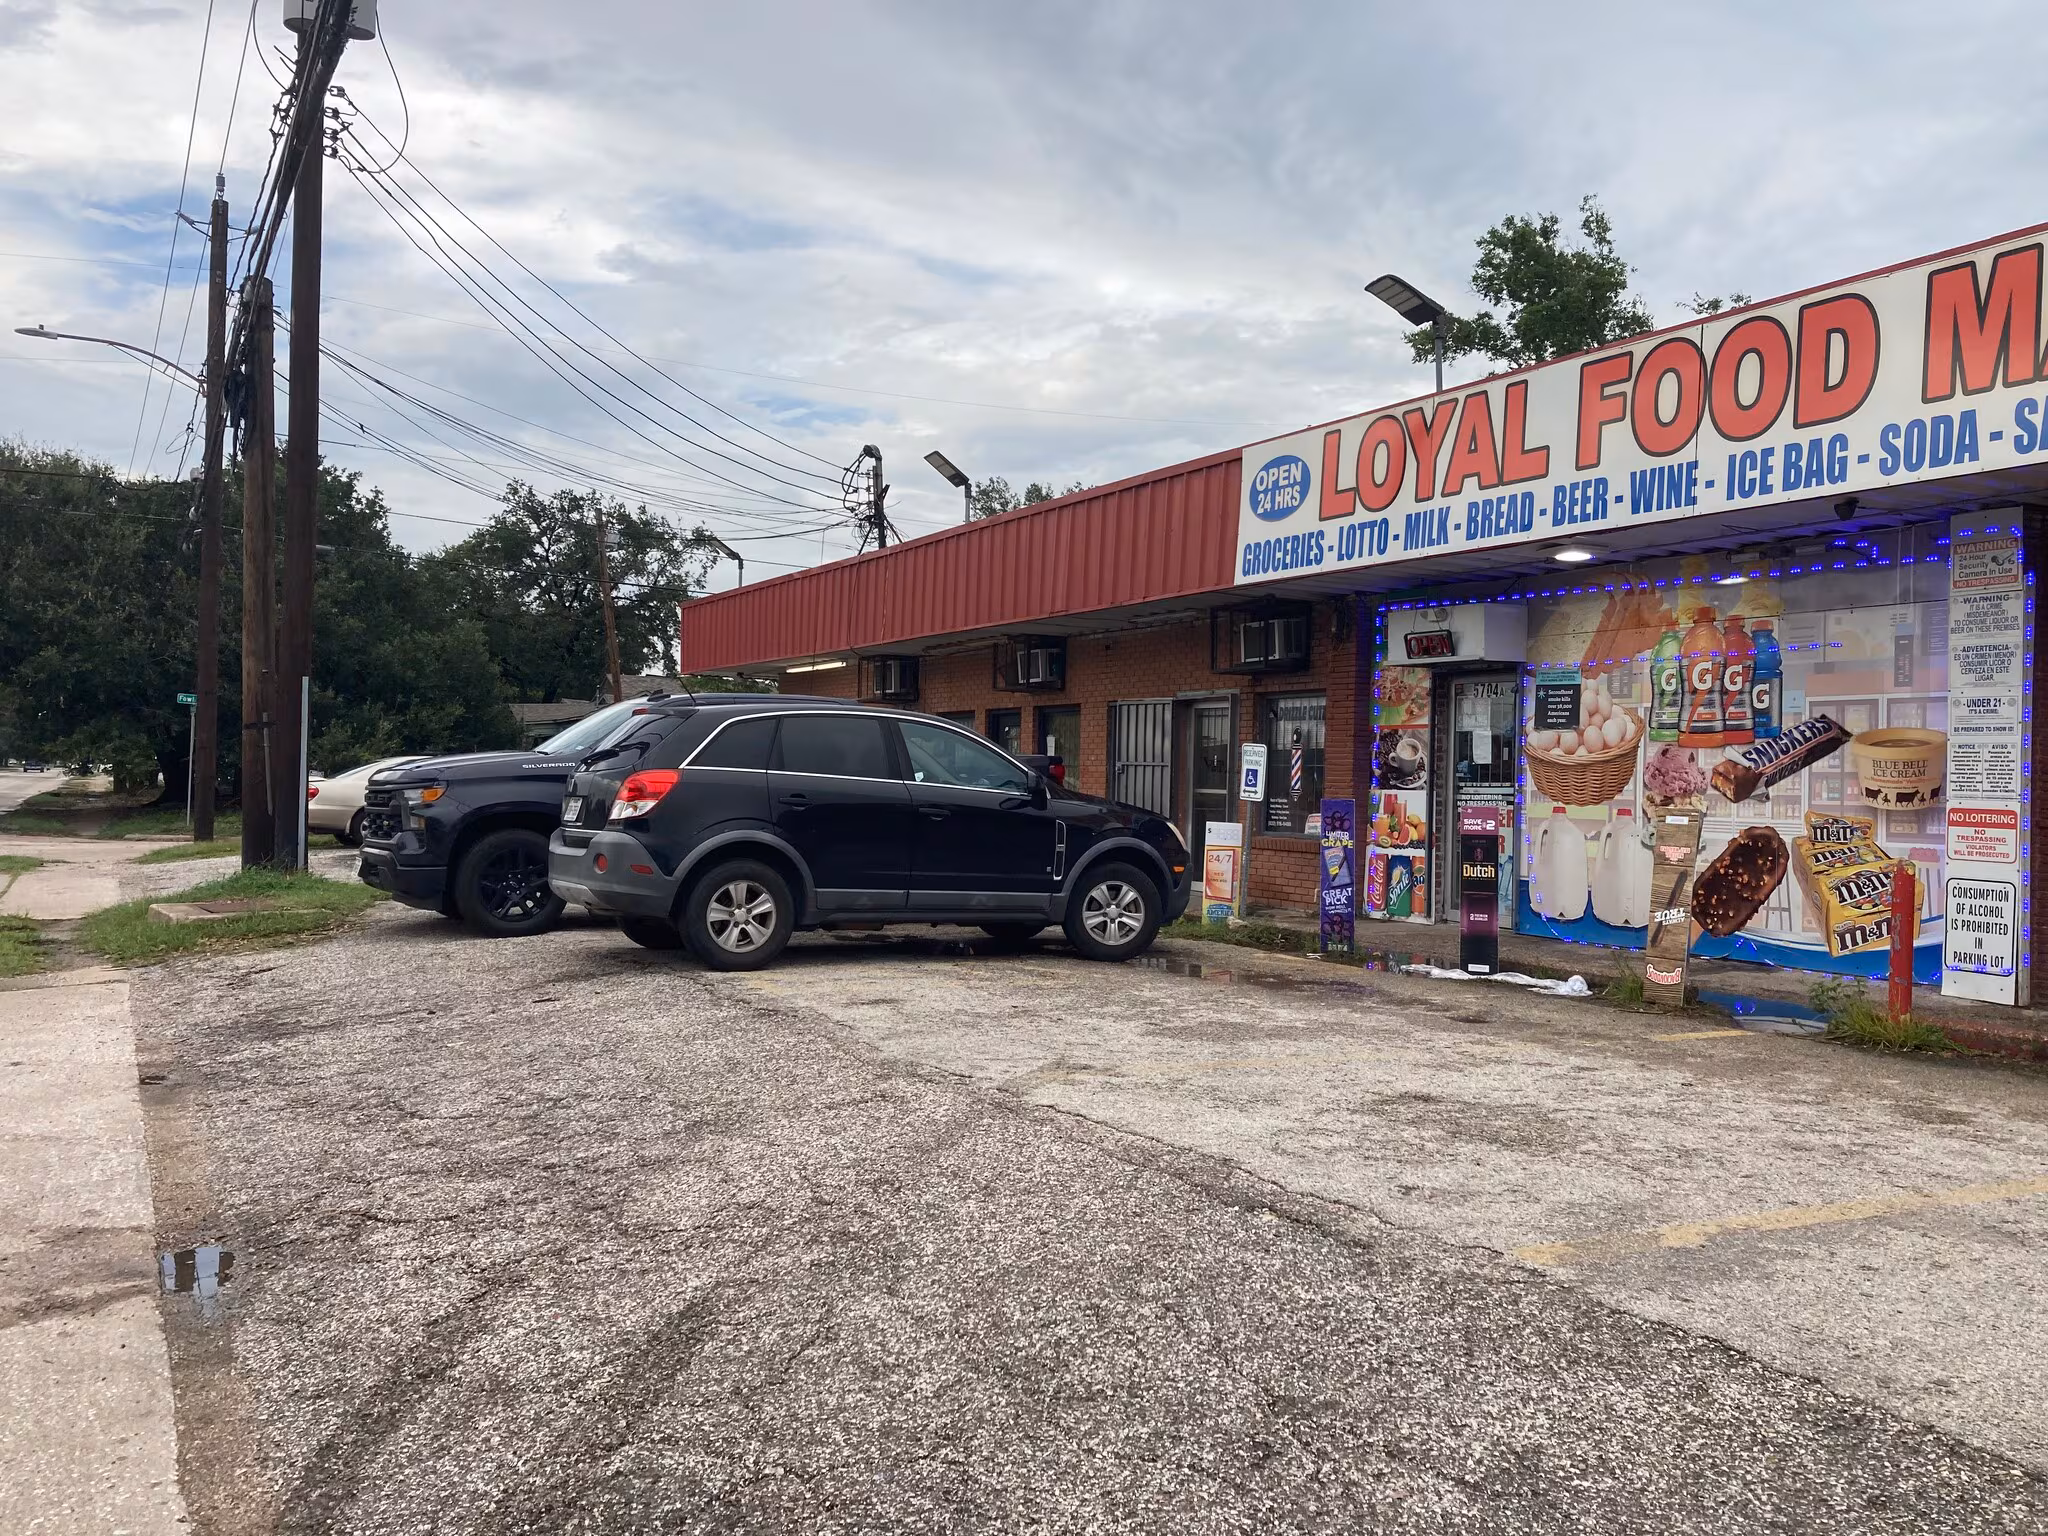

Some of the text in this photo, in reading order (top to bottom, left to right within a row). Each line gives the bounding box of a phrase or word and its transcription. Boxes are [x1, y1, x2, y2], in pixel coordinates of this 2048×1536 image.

[1319, 242, 2048, 521] LOYAL FOOD M
[1255, 461, 1303, 491] OPEN
[1242, 529, 1325, 577] GROCERIES
[1337, 517, 1389, 562] LOTTO
[1403, 505, 1451, 551] MILK
[1465, 491, 1535, 541] BREAD
[1552, 477, 1609, 527] BEER
[1630, 459, 1699, 515] WINE
[1726, 446, 1775, 501] ICE
[1782, 433, 1848, 492] BAG
[1879, 409, 1980, 477] SODA
[1257, 487, 1301, 514] 24 HRS
[1956, 538, 2017, 554] WARNING
[1959, 553, 1987, 562] 24 Hour
[1959, 561, 1989, 570] Security
[1959, 570, 1988, 579] Camera
[1968, 576, 2015, 586] TRESPASSING
[1962, 618, 1988, 626] CONSUME
[1989, 616, 2009, 624] LIQUOR
[1950, 626, 1965, 634] BEER
[1993, 623, 2020, 631] PREMISES
[1408, 634, 1451, 656] OPEN
[1971, 652, 1992, 660] CRIMEN
[1960, 660, 1988, 668] CONSUMIR
[1989, 659, 2006, 667] LICOR
[1960, 667, 1986, 675] CERVEZA
[1966, 698, 2001, 708] UNDER 21
[1741, 719, 1833, 771] SNICKERS
[1872, 759, 1929, 770] BLUE BELL
[1873, 768, 1926, 778] ICE CREAM
[1950, 812, 2015, 824] NO LOITERING
[1486, 820, 1495, 830] 2
[1321, 838, 1354, 849] GRAPE
[1956, 835, 2007, 843] TRESPASSING
[1208, 854, 1232, 863] 24/7
[1975, 851, 2010, 859] PROSECUTED
[1463, 864, 1495, 878] Dutch
[1322, 887, 1353, 899] GREAT
[1389, 873, 1409, 905] Sprite
[1952, 885, 2009, 903] CONSUMPTION
[1325, 895, 1348, 906] PICK
[1654, 907, 1686, 922] TRUE
[1956, 902, 2004, 919] OF ALCOHOL
[1951, 918, 2009, 936] IS PROHIBITED
[1974, 937, 1983, 950] IN
[1953, 951, 2004, 969] PARKING LOT
